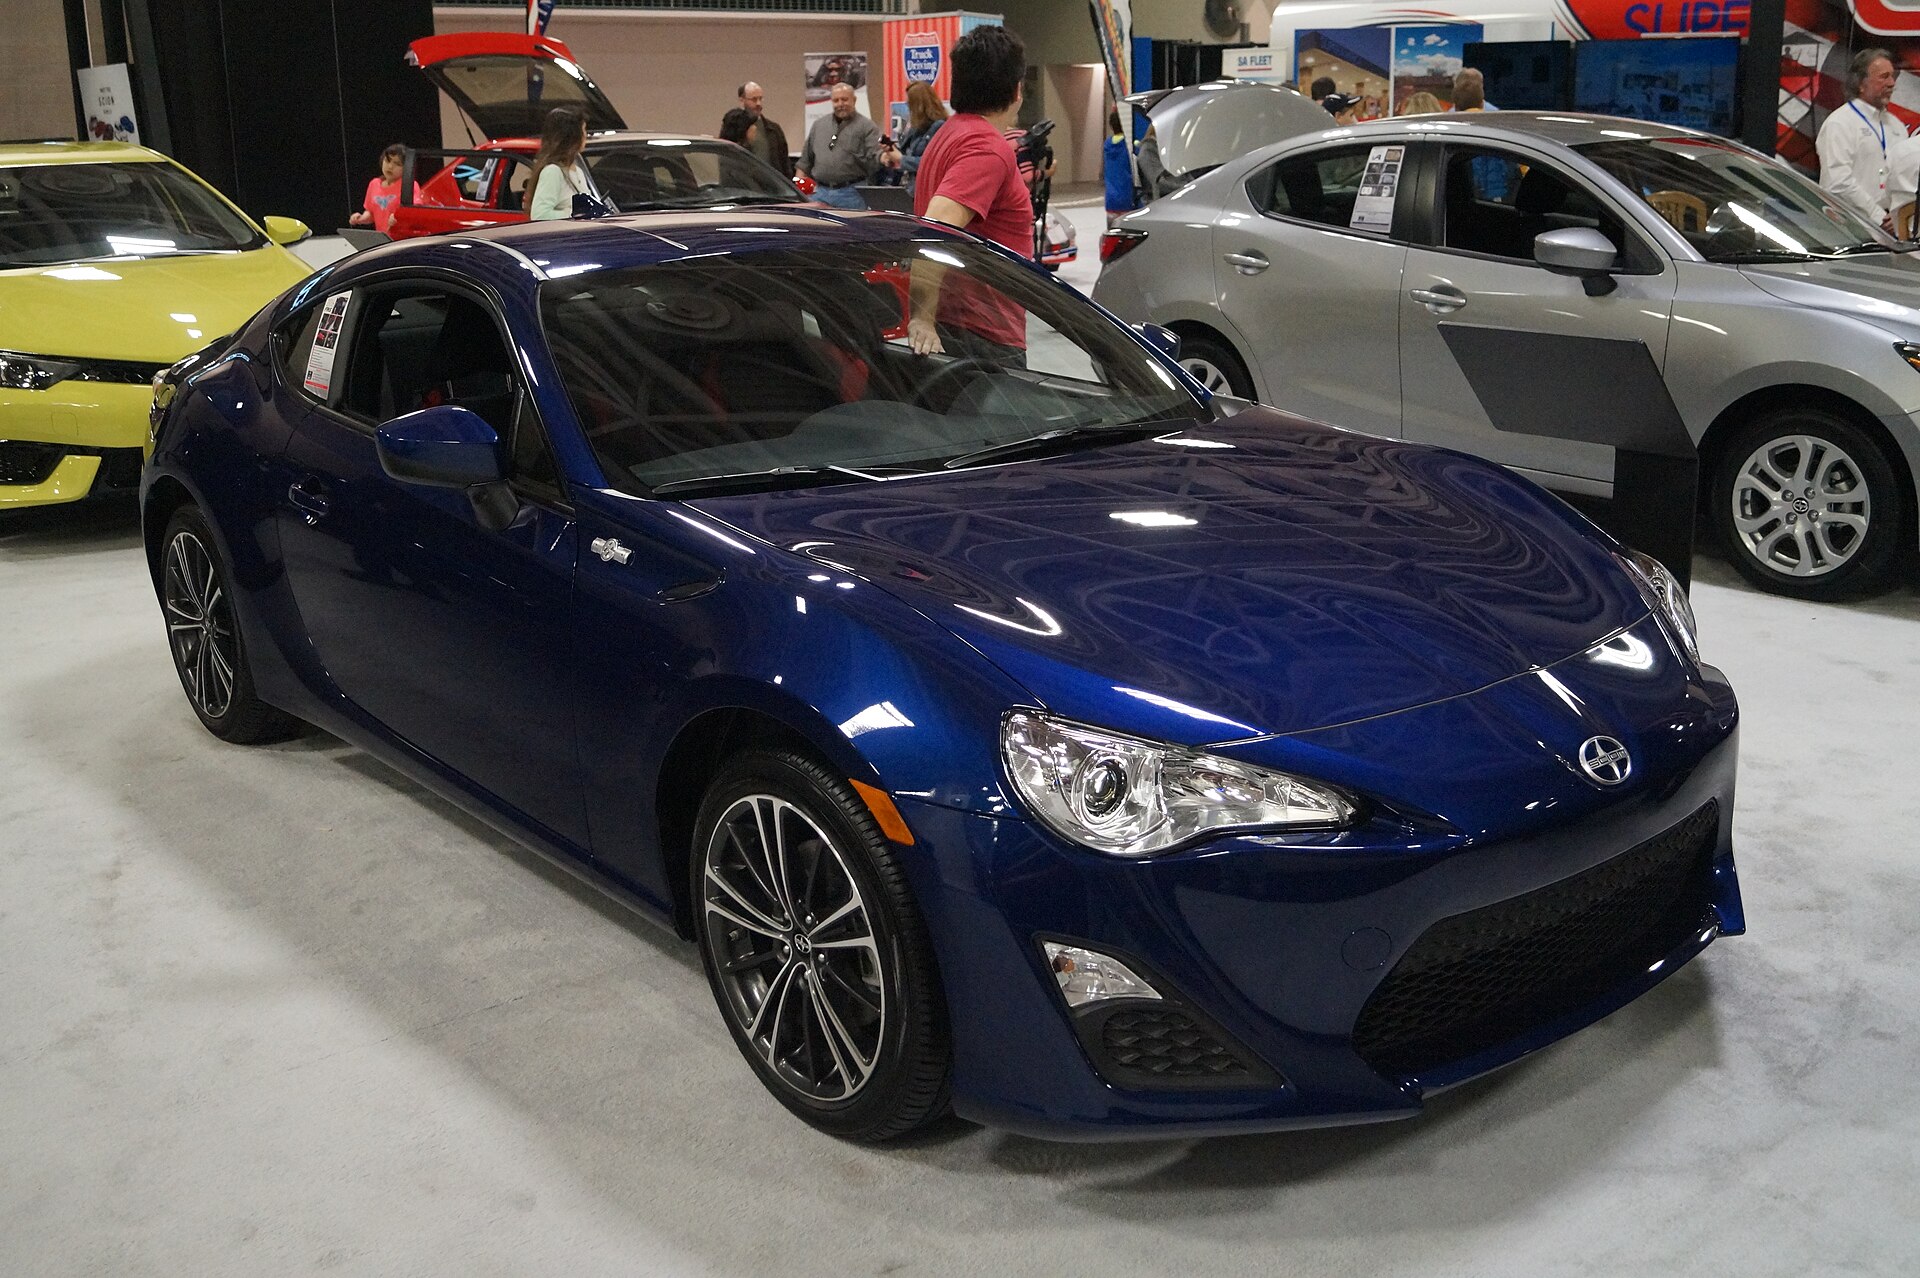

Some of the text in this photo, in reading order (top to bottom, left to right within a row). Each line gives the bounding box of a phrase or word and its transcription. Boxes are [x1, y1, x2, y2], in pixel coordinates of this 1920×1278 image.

[910, 48, 934, 60] Truck
[907, 59, 938, 71] Driving
[1238, 55, 1272, 67] SA FLEET
[909, 70, 935, 81] School
